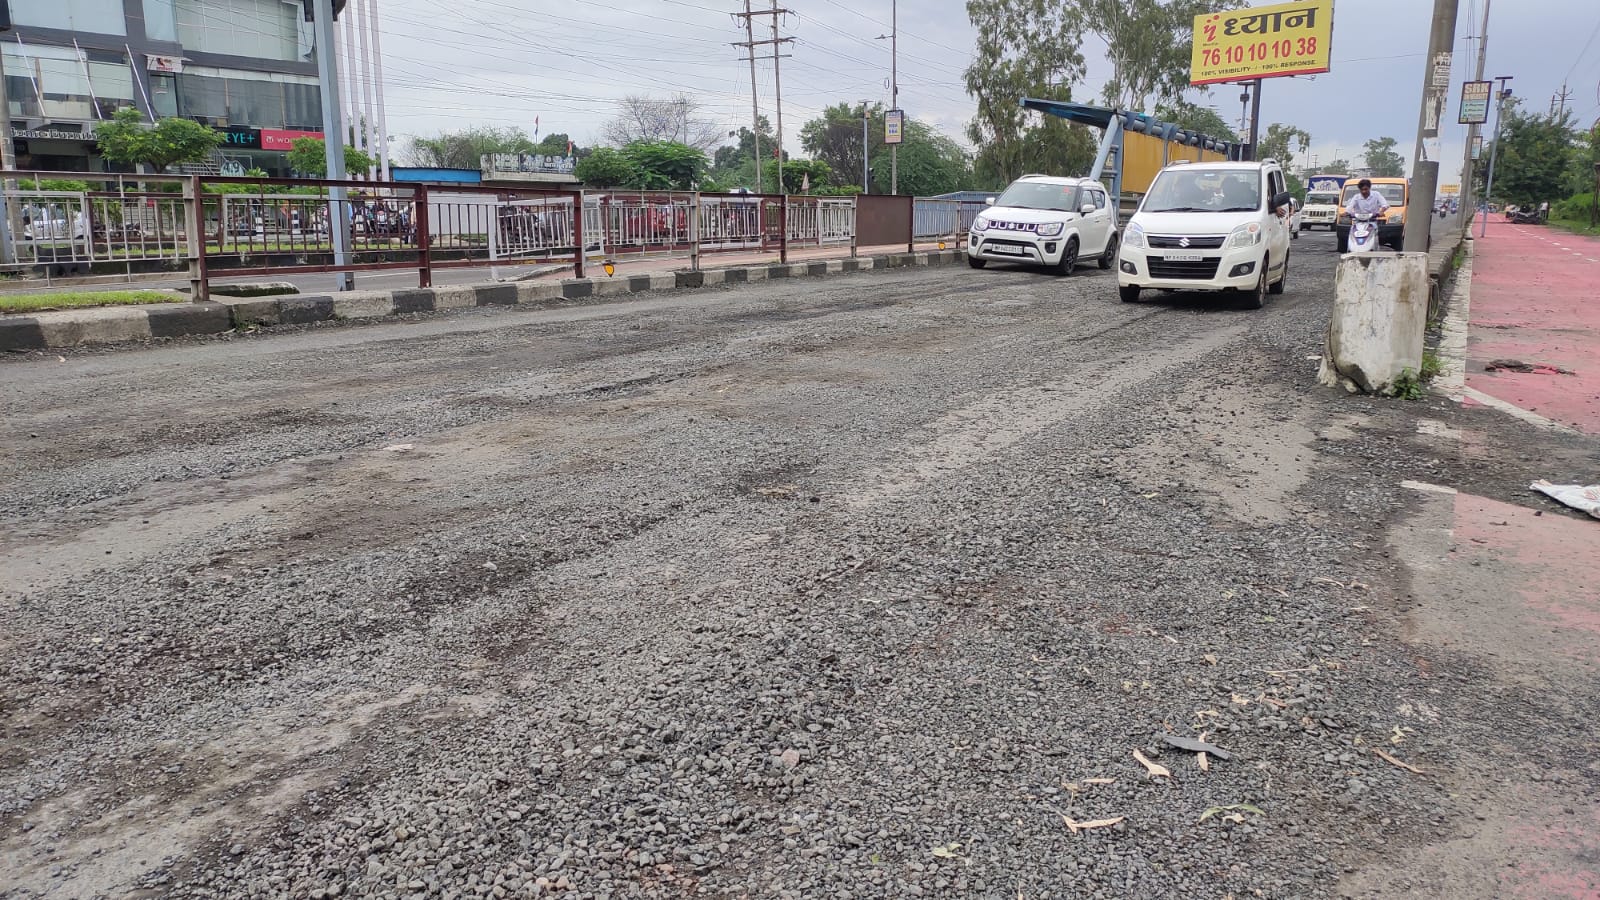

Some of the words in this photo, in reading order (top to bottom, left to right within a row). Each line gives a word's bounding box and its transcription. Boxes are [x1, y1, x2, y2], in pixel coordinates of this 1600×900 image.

[1224, 7, 1319, 36] ध्यान
[1202, 48, 1221, 67] 76
[1225, 45, 1244, 64] 10
[1248, 42, 1267, 62] 10
[1272, 39, 1291, 58] 10
[1296, 37, 1317, 56] 38
[1218, 67, 1251, 75] VISIBILITY
[1280, 59, 1317, 68] RESPONSE
[1464, 83, 1489, 94] SRK
